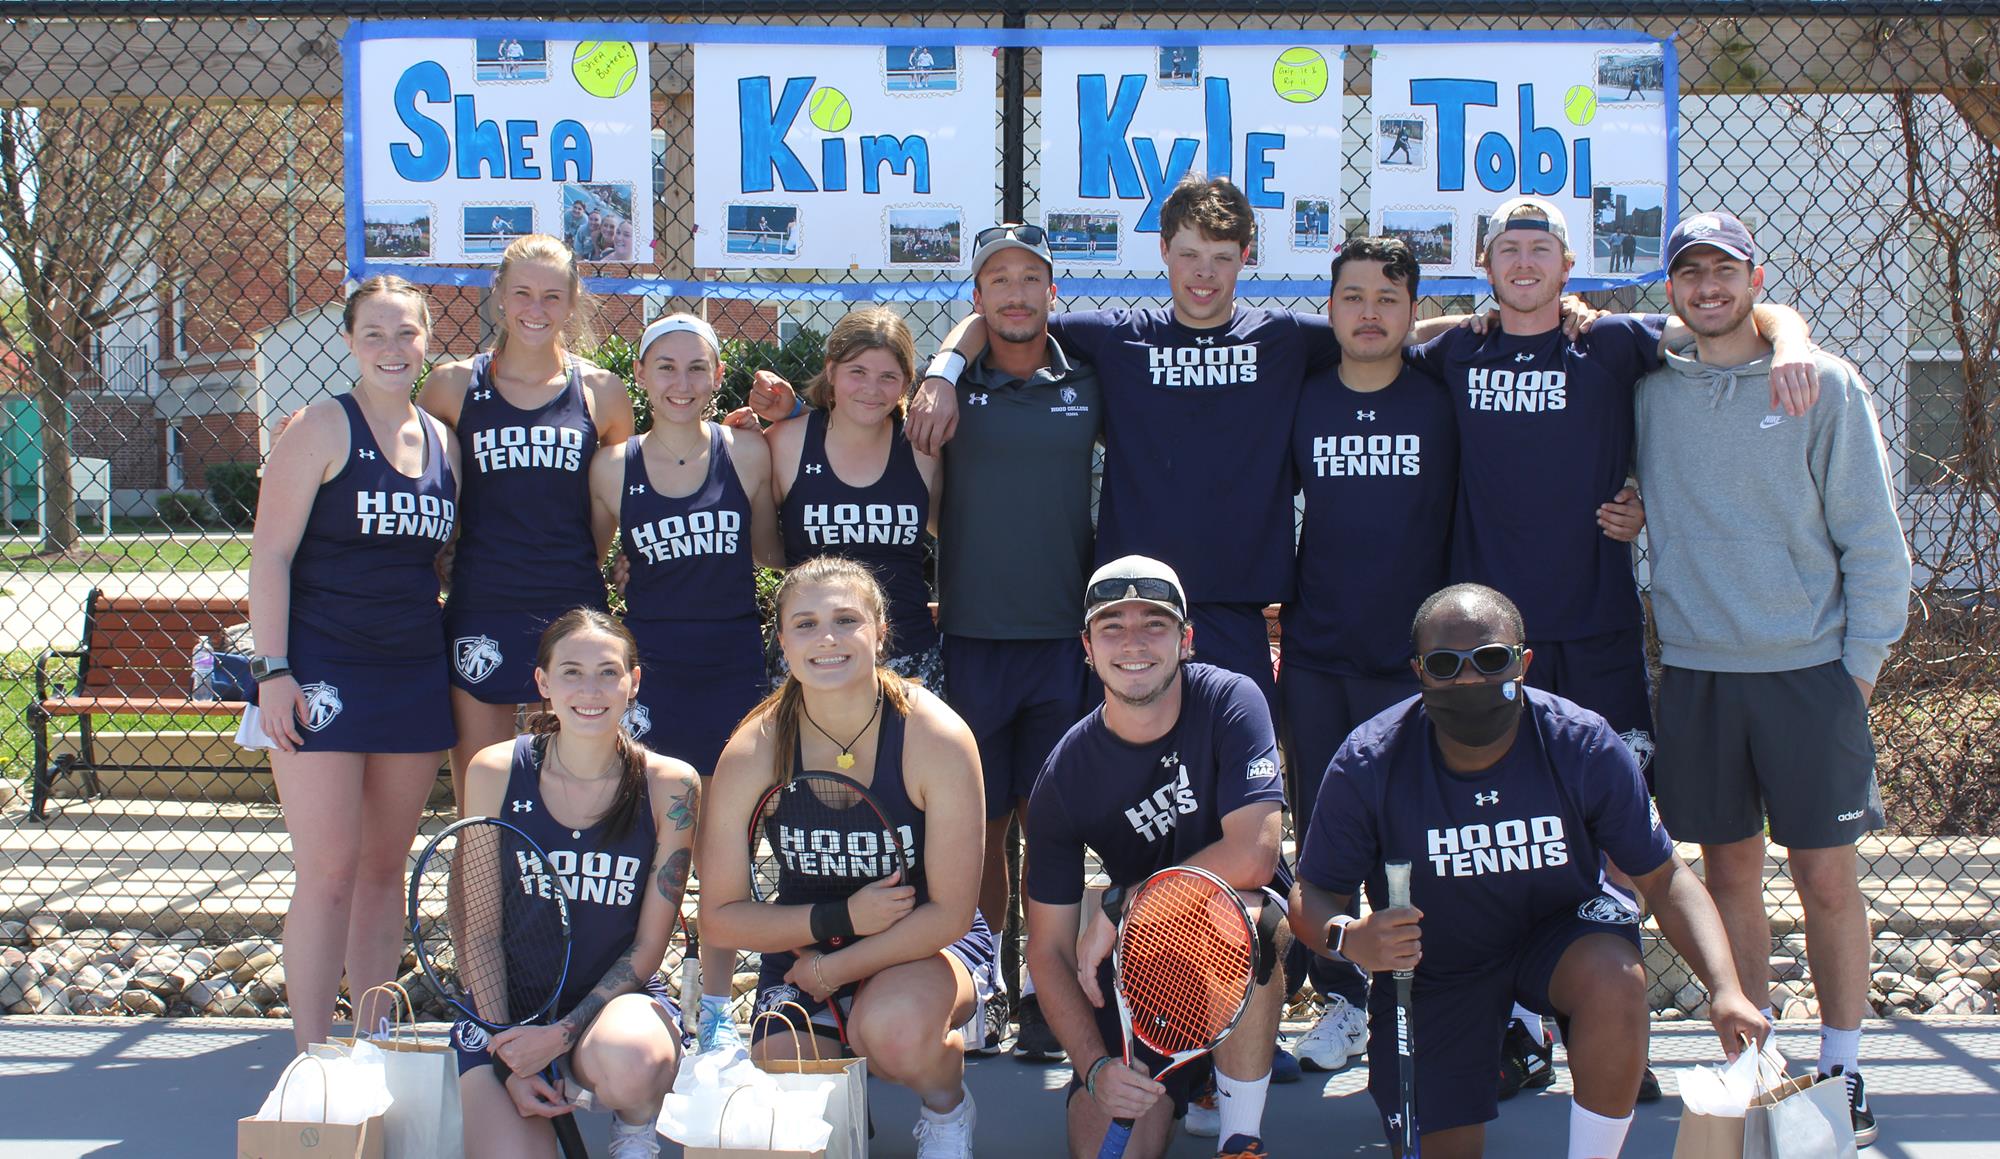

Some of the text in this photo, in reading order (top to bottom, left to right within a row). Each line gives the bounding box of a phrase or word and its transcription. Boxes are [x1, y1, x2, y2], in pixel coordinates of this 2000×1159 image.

[737, 75, 931, 194] Kim
[1149, 345, 1257, 367] HOOD
[1149, 364, 1257, 386] TENNIS
[1467, 367, 1566, 391] HOOD
[1467, 388, 1567, 412] TENNIS
[473, 426, 583, 453] HOOD
[1313, 434, 1420, 457] HOOD
[474, 446, 582, 473] TENNIS
[1313, 455, 1420, 476] TENNIS
[357, 491, 454, 523] HOOD
[803, 504, 919, 526] HOOD
[357, 513, 452, 542] TENNIS
[631, 510, 740, 549] HOOD
[803, 524, 918, 545] TENNIS
[638, 532, 739, 565] TENNIS
[1249, 767, 1274, 777] MAC
[1427, 815, 1565, 855] HOOD
[516, 850, 641, 882] HOOD
[1428, 841, 1568, 877] TENNIS
[519, 873, 636, 906] TENNIS
[1137, 1034, 1164, 1055] HEAD
